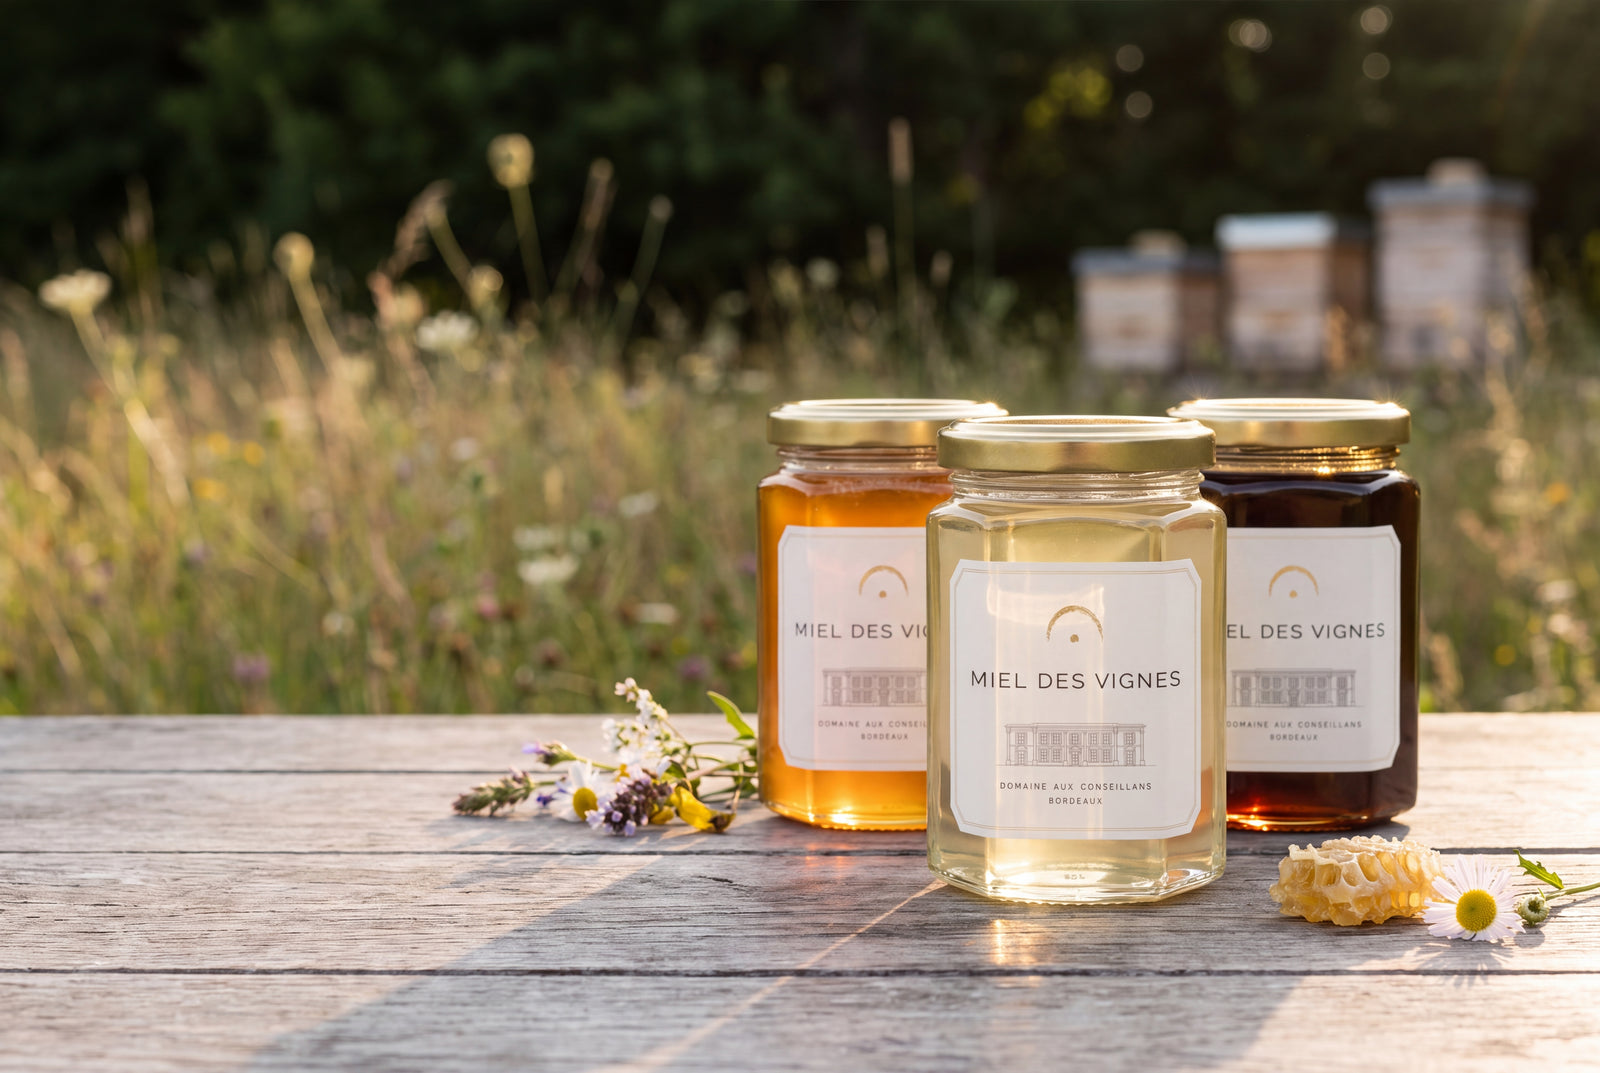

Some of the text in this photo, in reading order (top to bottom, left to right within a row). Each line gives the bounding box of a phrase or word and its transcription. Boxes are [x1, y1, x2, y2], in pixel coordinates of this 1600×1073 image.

[795, 622, 842, 639] MIEL
[851, 623, 893, 639] DES
[1260, 623, 1303, 640] DES
[1311, 622, 1385, 640] VIGNES
[971, 670, 1181, 690] MIEL DES VIGNES
[818, 719, 860, 728] DOMAINE
[865, 720, 883, 728] AUX
[1226, 720, 1362, 729] DOMAINE AUX CONSEILLANS
[860, 732, 909, 741] BORDEAUX
[1269, 733, 1318, 742] BORDEAUX
[999, 782, 1152, 791] DOMAINE AUX CONSEILLANS
[1048, 796, 1103, 805] BORDEAUX
